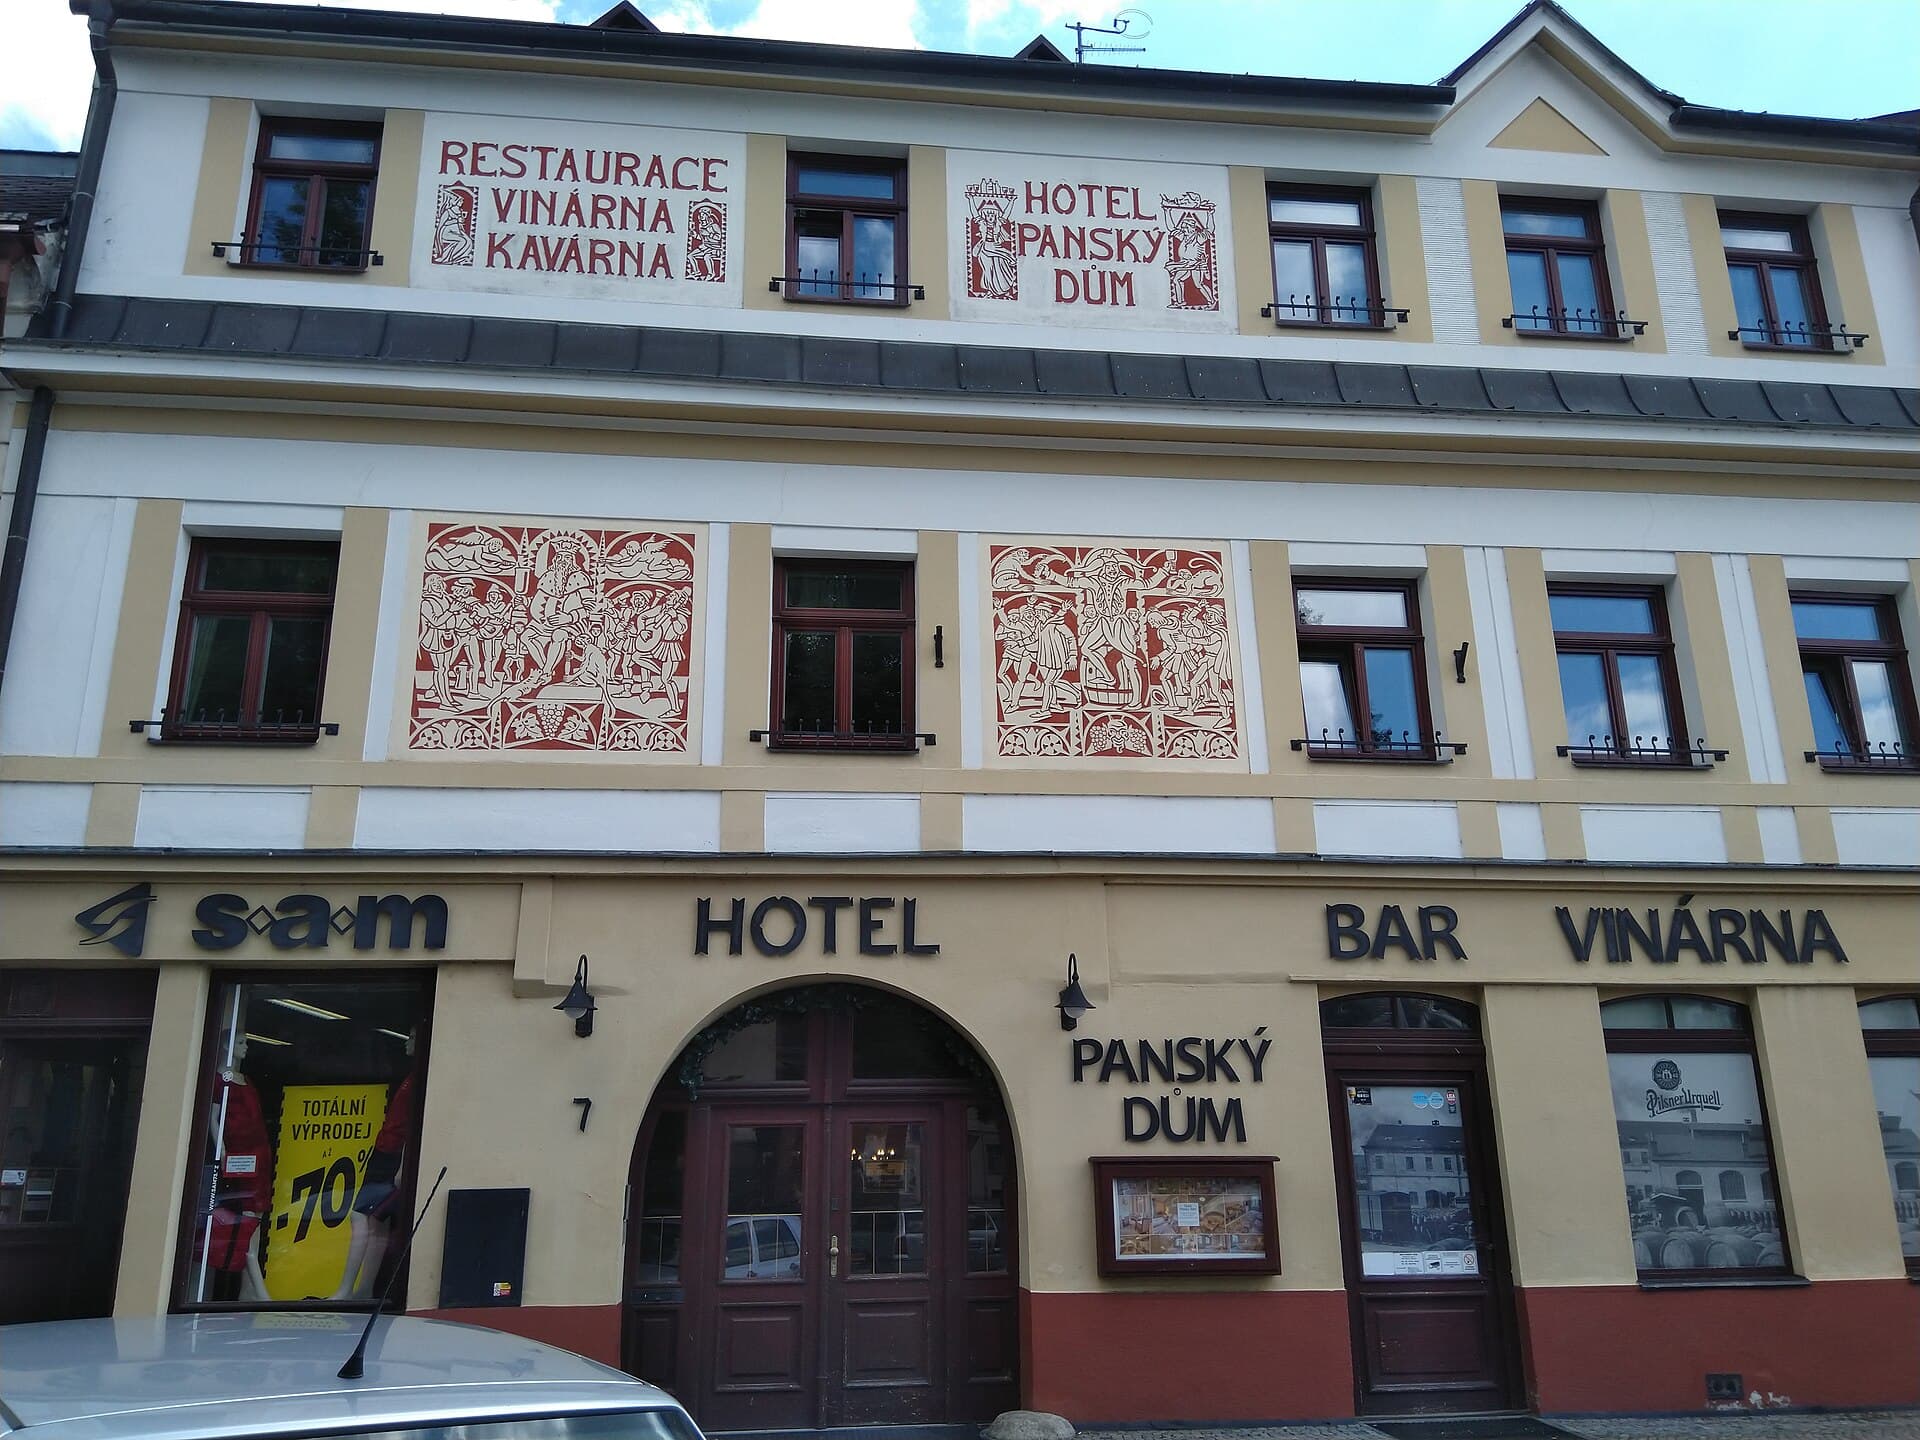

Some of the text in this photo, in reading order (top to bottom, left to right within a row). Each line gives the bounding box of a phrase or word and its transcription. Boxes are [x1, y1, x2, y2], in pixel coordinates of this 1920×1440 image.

[439, 140, 729, 193] RESTAURACE
[491, 188, 675, 234] VINÁRNA
[1024, 181, 1157, 221] HOTEL
[485, 233, 674, 279] KAVÁRNA
[1017, 222, 1166, 263] PANSKÝ
[1054, 264, 1136, 307] DŮM
[694, 896, 940, 956] HOTEL
[1325, 903, 1468, 961] BAR
[1555, 894, 1850, 963] VINÁRNA
[1072, 1026, 1272, 1083] PANSKÝ
[303, 1096, 367, 1117] TOTÁLNÍ
[573, 1097, 592, 1133] 7
[1123, 1087, 1247, 1143] DŮM
[1646, 1087, 1721, 1118] Pilsner Urquell
[292, 1119, 372, 1141] VÝPRODEJ
